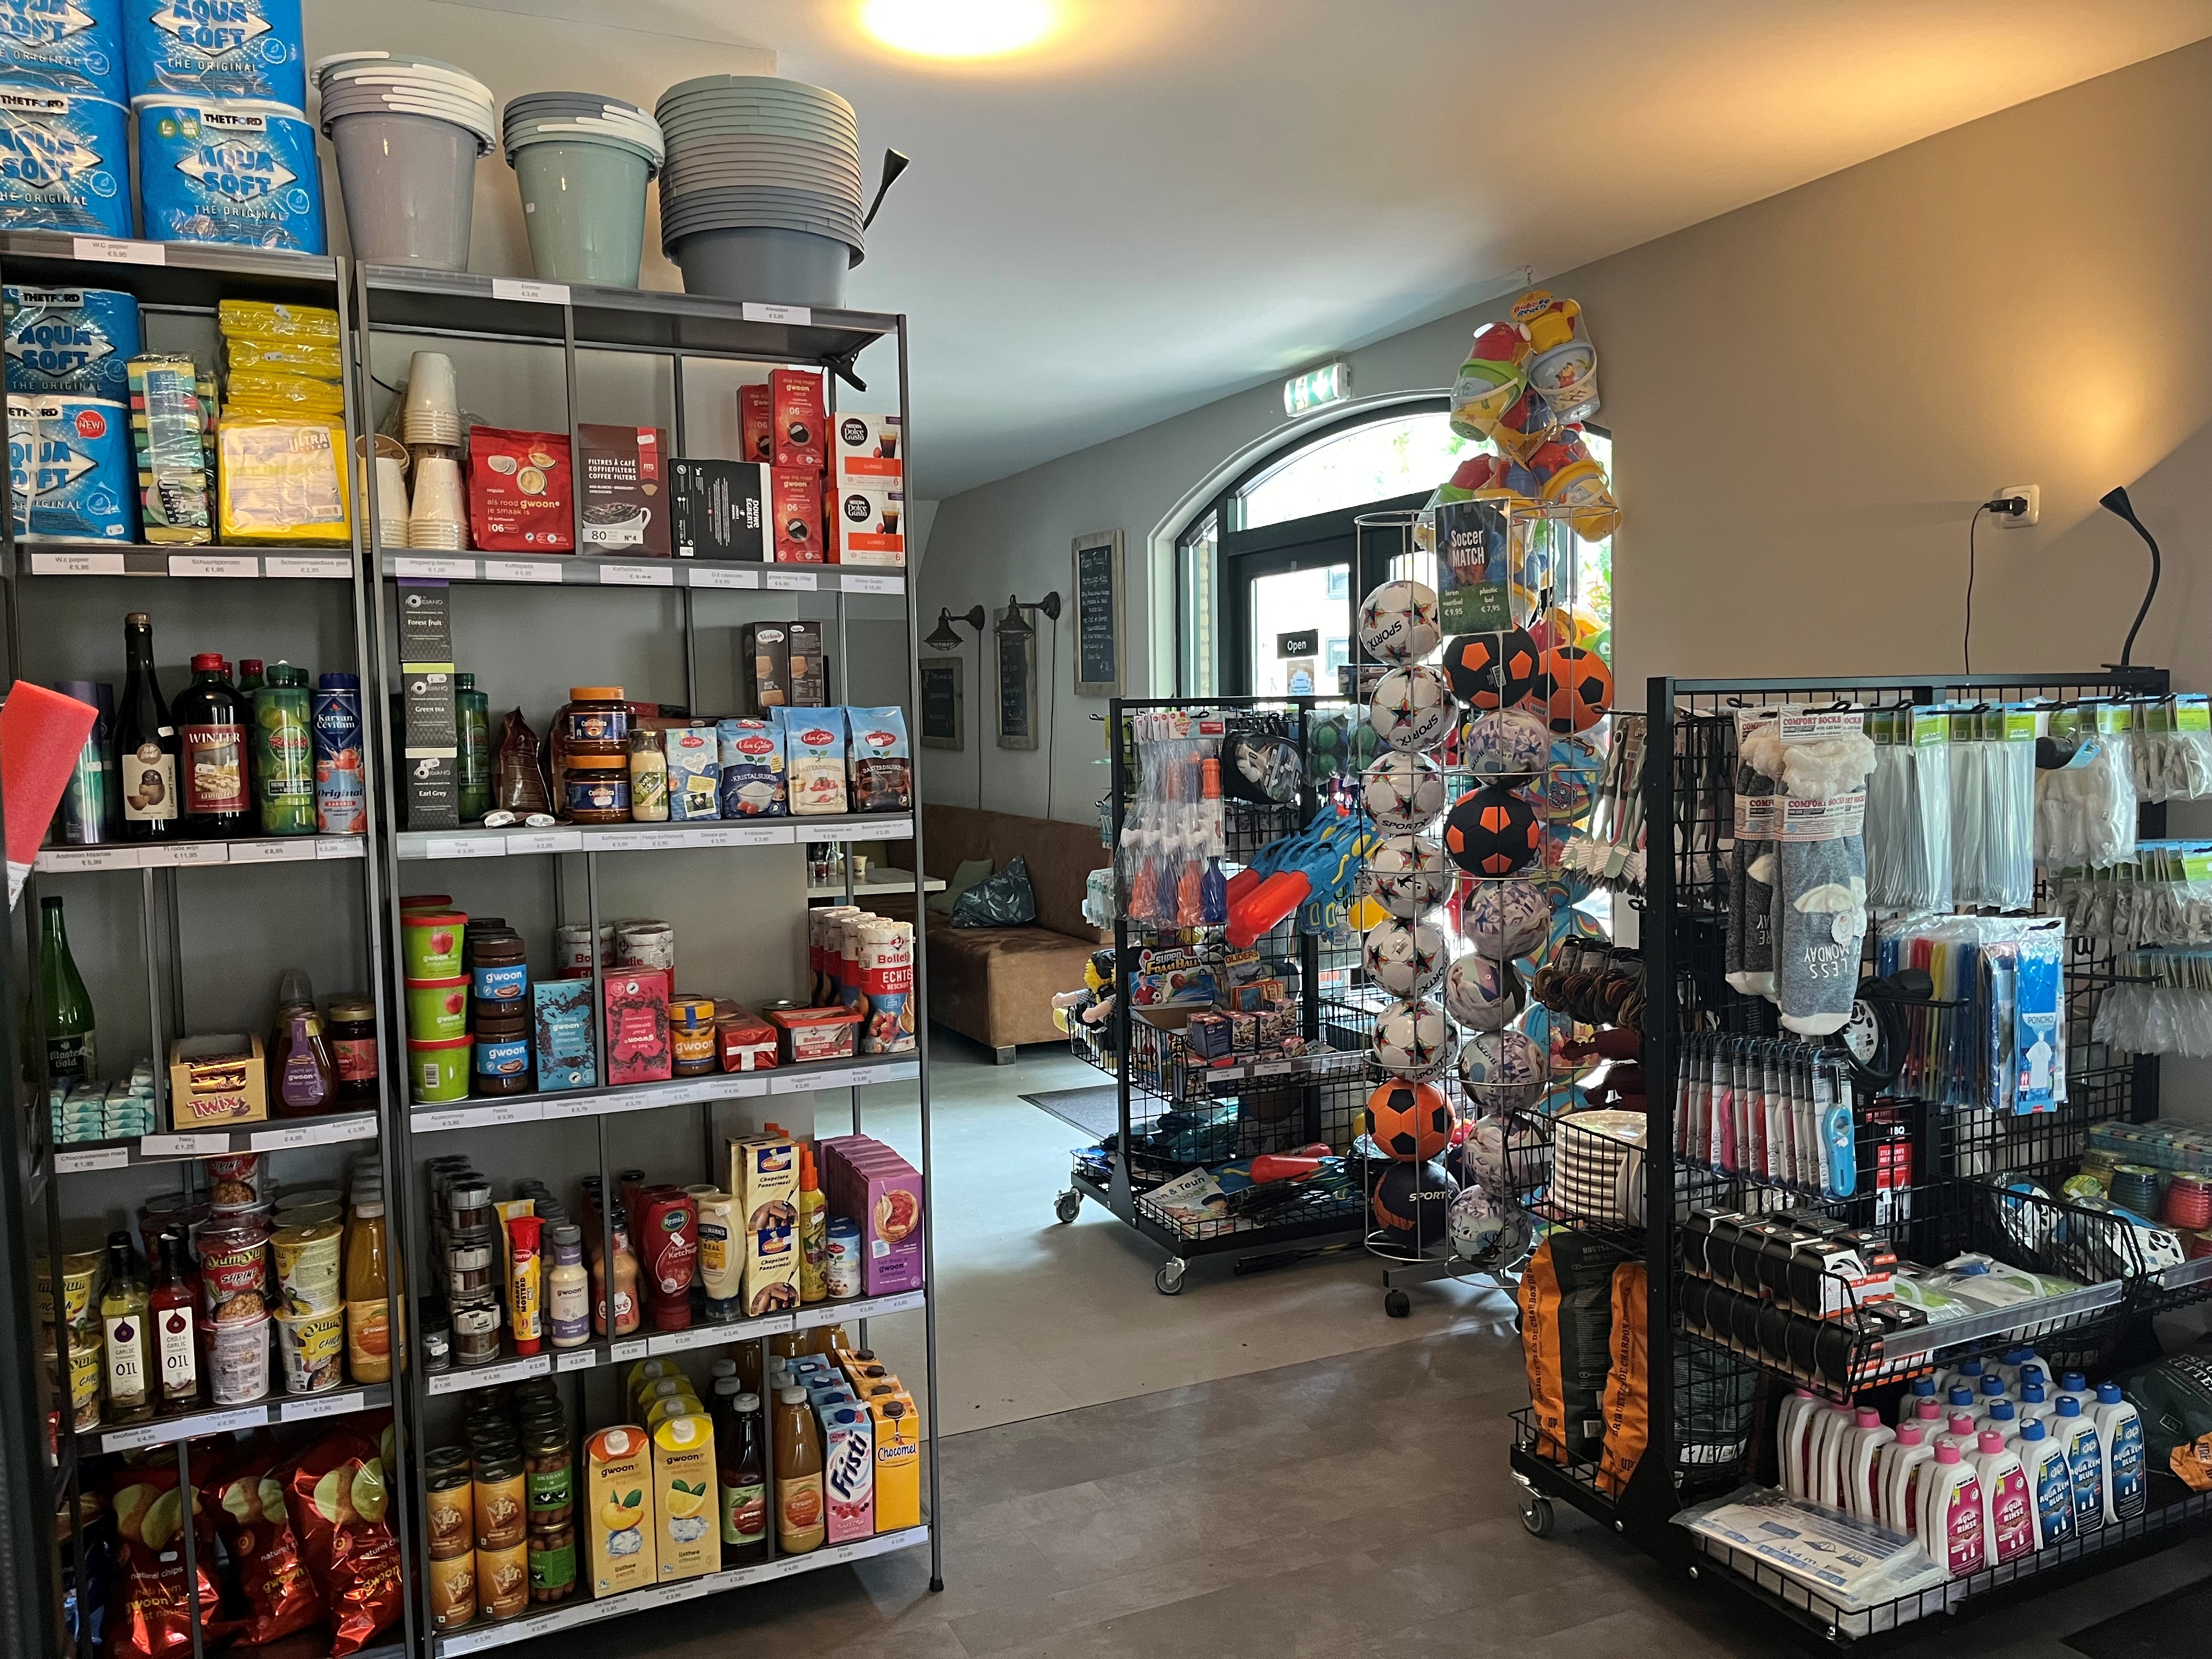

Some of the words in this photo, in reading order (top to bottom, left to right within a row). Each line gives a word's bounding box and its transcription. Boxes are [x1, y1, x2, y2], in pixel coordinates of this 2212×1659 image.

[178, 25, 246, 50] SOFT
[168, 58, 191, 70] THE
[198, 60, 258, 72] ORIGINAL
[204, 114, 263, 127] THETFORD
[198, 144, 275, 173] AQUA
[204, 171, 271, 197] SOFT
[25, 193, 88, 206] ORIGINAL
[194, 205, 218, 215] THE
[224, 207, 286, 221] ORIGINAL
[108, 242, 129, 251] papier
[23, 292, 80, 303] THETFORD
[18, 325, 92, 346] AQUA
[20, 350, 89, 370] SOFT
[12, 381, 34, 391] THE
[41, 381, 103, 391] ORIGINAL
[786, 384, 810, 393] gwoon
[789, 407, 800, 415] 06
[78, 419, 104, 430] NEW!
[289, 433, 329, 453] ULTRA
[588, 459, 612, 467] FILTRES
[620, 458, 636, 467] CAFÉ
[588, 466, 637, 475] KOFFIEFILTERS
[783, 481, 808, 489] gwoon
[893, 478, 899, 486] 6
[520, 499, 555, 509] gwoon
[787, 504, 798, 512] 06
[487, 507, 495, 515] je
[491, 524, 505, 533] 06
[591, 531, 607, 541] 80
[1451, 529, 1485, 548] Soccer
[895, 552, 901, 561] 6
[1452, 547, 1485, 568] MATCH
[1444, 589, 1460, 597] leren
[1479, 586, 1498, 596] plastic
[1442, 597, 1464, 607] voetbal
[428, 618, 442, 627] fruit
[1367, 620, 1402, 651] SPORTX
[1287, 639, 1307, 652] Open
[318, 714, 353, 722] Karvan
[1783, 717, 1817, 726] COMFORT
[1818, 716, 1842, 725] SOCKS
[1400, 713, 1439, 747] SPORTX
[189, 732, 241, 743] WINTER
[803, 734, 816, 743] Van
[816, 733, 833, 743] Gilse
[738, 740, 753, 751] Van
[753, 740, 773, 751] Gilse
[862, 765, 904, 774] BASTERDSUIKER
[732, 774, 778, 783] KRISTALSUIKER
[318, 788, 363, 800] Original
[1788, 799, 1826, 808] COMFORT
[1381, 817, 1431, 831] SPORTX
[1155, 951, 1182, 964] SUPER
[1225, 951, 1260, 966] GLIDERS
[1804, 944, 1850, 962] MONDAY
[1146, 957, 1200, 974] FOAMBALL
[1811, 960, 1848, 979] LESS
[486, 970, 522, 984] gwoon
[882, 970, 912, 984] ECHTE
[437, 1016, 461, 1024] gwoon
[2028, 1015, 2054, 1024] PONCHO
[552, 1022, 580, 1032] gwoon
[627, 1034, 654, 1044] gwoon
[488, 1045, 525, 1059] gwoon
[675, 1040, 714, 1054] gwoon
[55, 1059, 78, 1069] Gold
[1412, 1050, 1453, 1081] SPORTX
[187, 1096, 239, 1119] Twix
[760, 1175, 788, 1183] Chapelure
[1177, 1176, 1206, 1191] Teun
[1408, 1188, 1453, 1202] SPORTX
[664, 1215, 685, 1226] Remia
[703, 1243, 720, 1251] REAL
[668, 1248, 697, 1260] Ketchup
[760, 1256, 789, 1266] Chapelure
[879, 1263, 904, 1273] gwoon
[221, 1270, 258, 1284] SHRIMP
[557, 1287, 582, 1297] gwoon
[167, 1356, 188, 1369] OIL
[116, 1363, 137, 1376] OIL
[878, 1443, 917, 1461] Chocomel
[666, 1454, 699, 1464] gwoon
[830, 1430, 868, 1500] Fristi
[2122, 1455, 2136, 1467] BLUE
[601, 1464, 635, 1478] gwoon
[2078, 1469, 2094, 1481] BLUE
[2049, 1493, 2064, 1506] BLUE
[740, 1510, 761, 1520] gwoon
[2004, 1508, 2024, 1523] RINSE
[1957, 1521, 1977, 1534] RINSE
[678, 1555, 701, 1564] citroen
[131, 1571, 159, 1580] naturel
[160, 1566, 184, 1578] chips
[616, 1569, 635, 1578] perzik
[125, 1597, 168, 1612] gwoon
